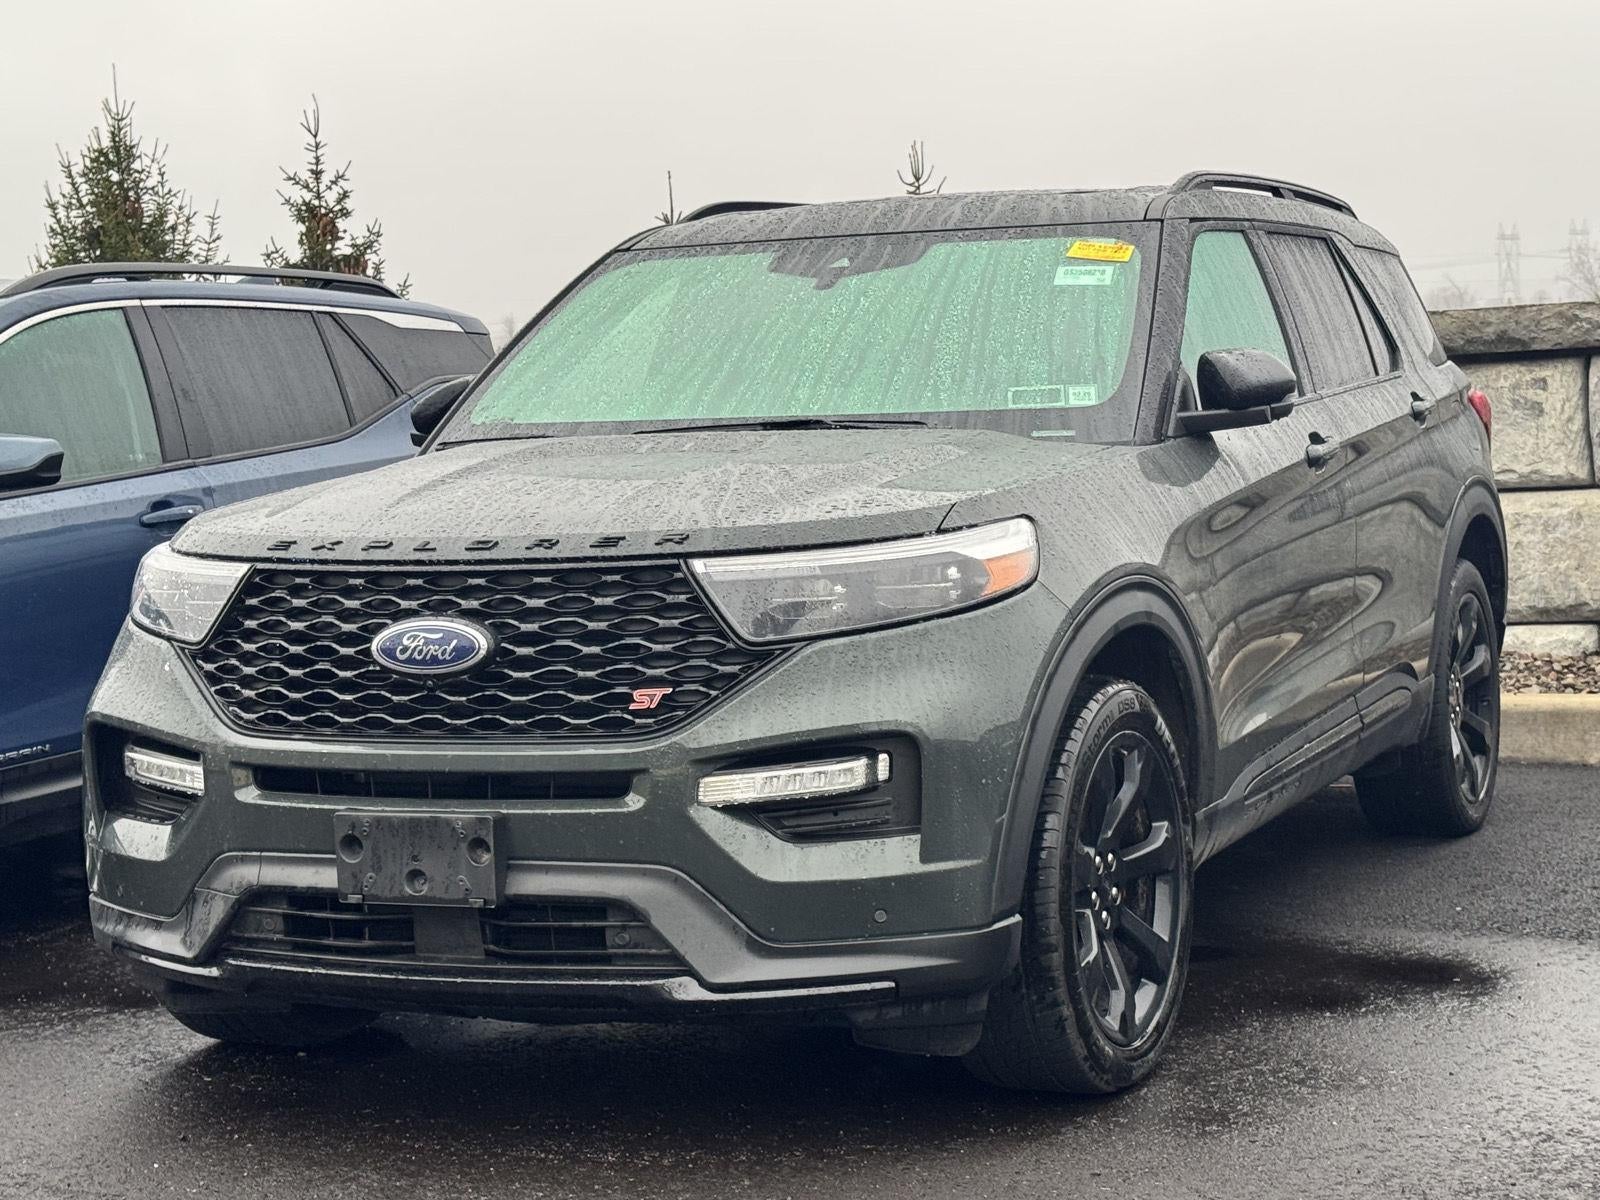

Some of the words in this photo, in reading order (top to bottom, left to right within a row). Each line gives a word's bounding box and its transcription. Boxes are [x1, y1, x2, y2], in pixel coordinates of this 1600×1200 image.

[266, 532, 690, 552] EXPLORER
[396, 631, 456, 662] Ford
[628, 687, 673, 710] ST
